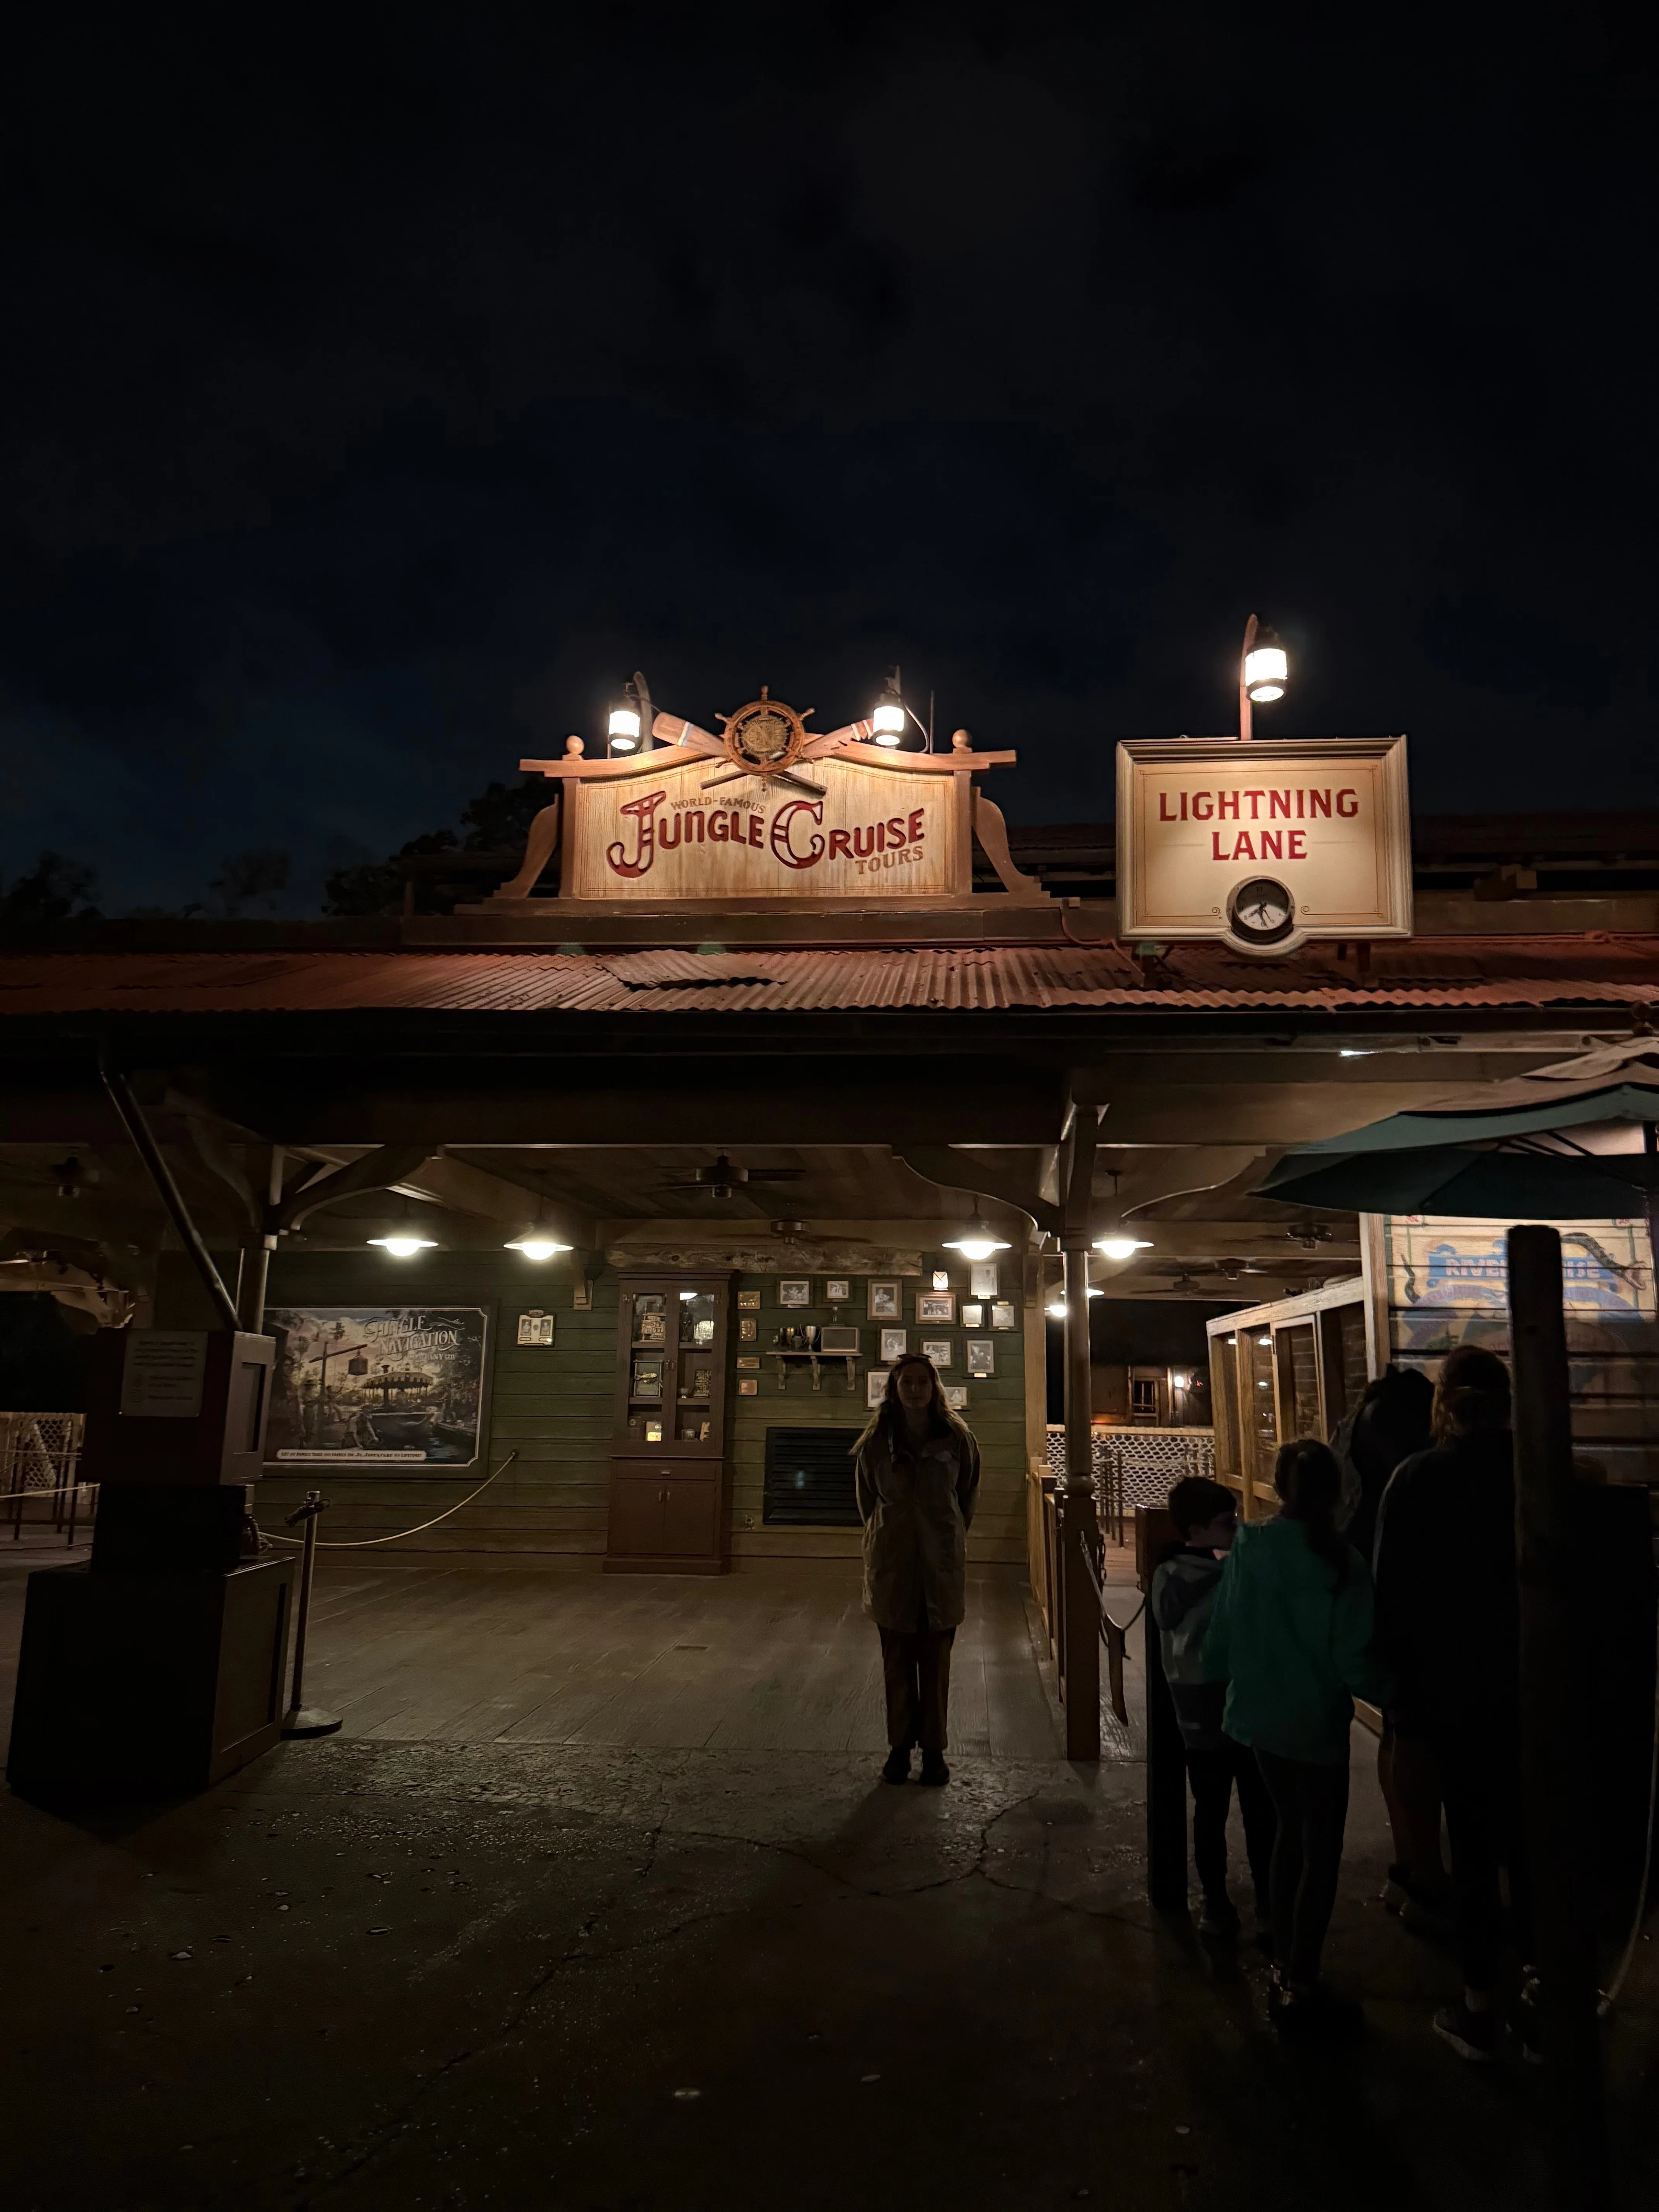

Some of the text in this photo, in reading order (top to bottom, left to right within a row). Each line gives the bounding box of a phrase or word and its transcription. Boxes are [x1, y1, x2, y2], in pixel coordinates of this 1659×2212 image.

[671, 797, 766, 814] WORLD-FAMOUS
[1159, 789, 1359, 821] LIGHTNING
[606, 790, 924, 878] JUNGLE CRUISE
[1212, 830, 1307, 860] LANE
[855, 846, 924, 874] TOURS
[363, 1316, 432, 1343] JUNGLE
[379, 1330, 460, 1355] NAVIGATION
